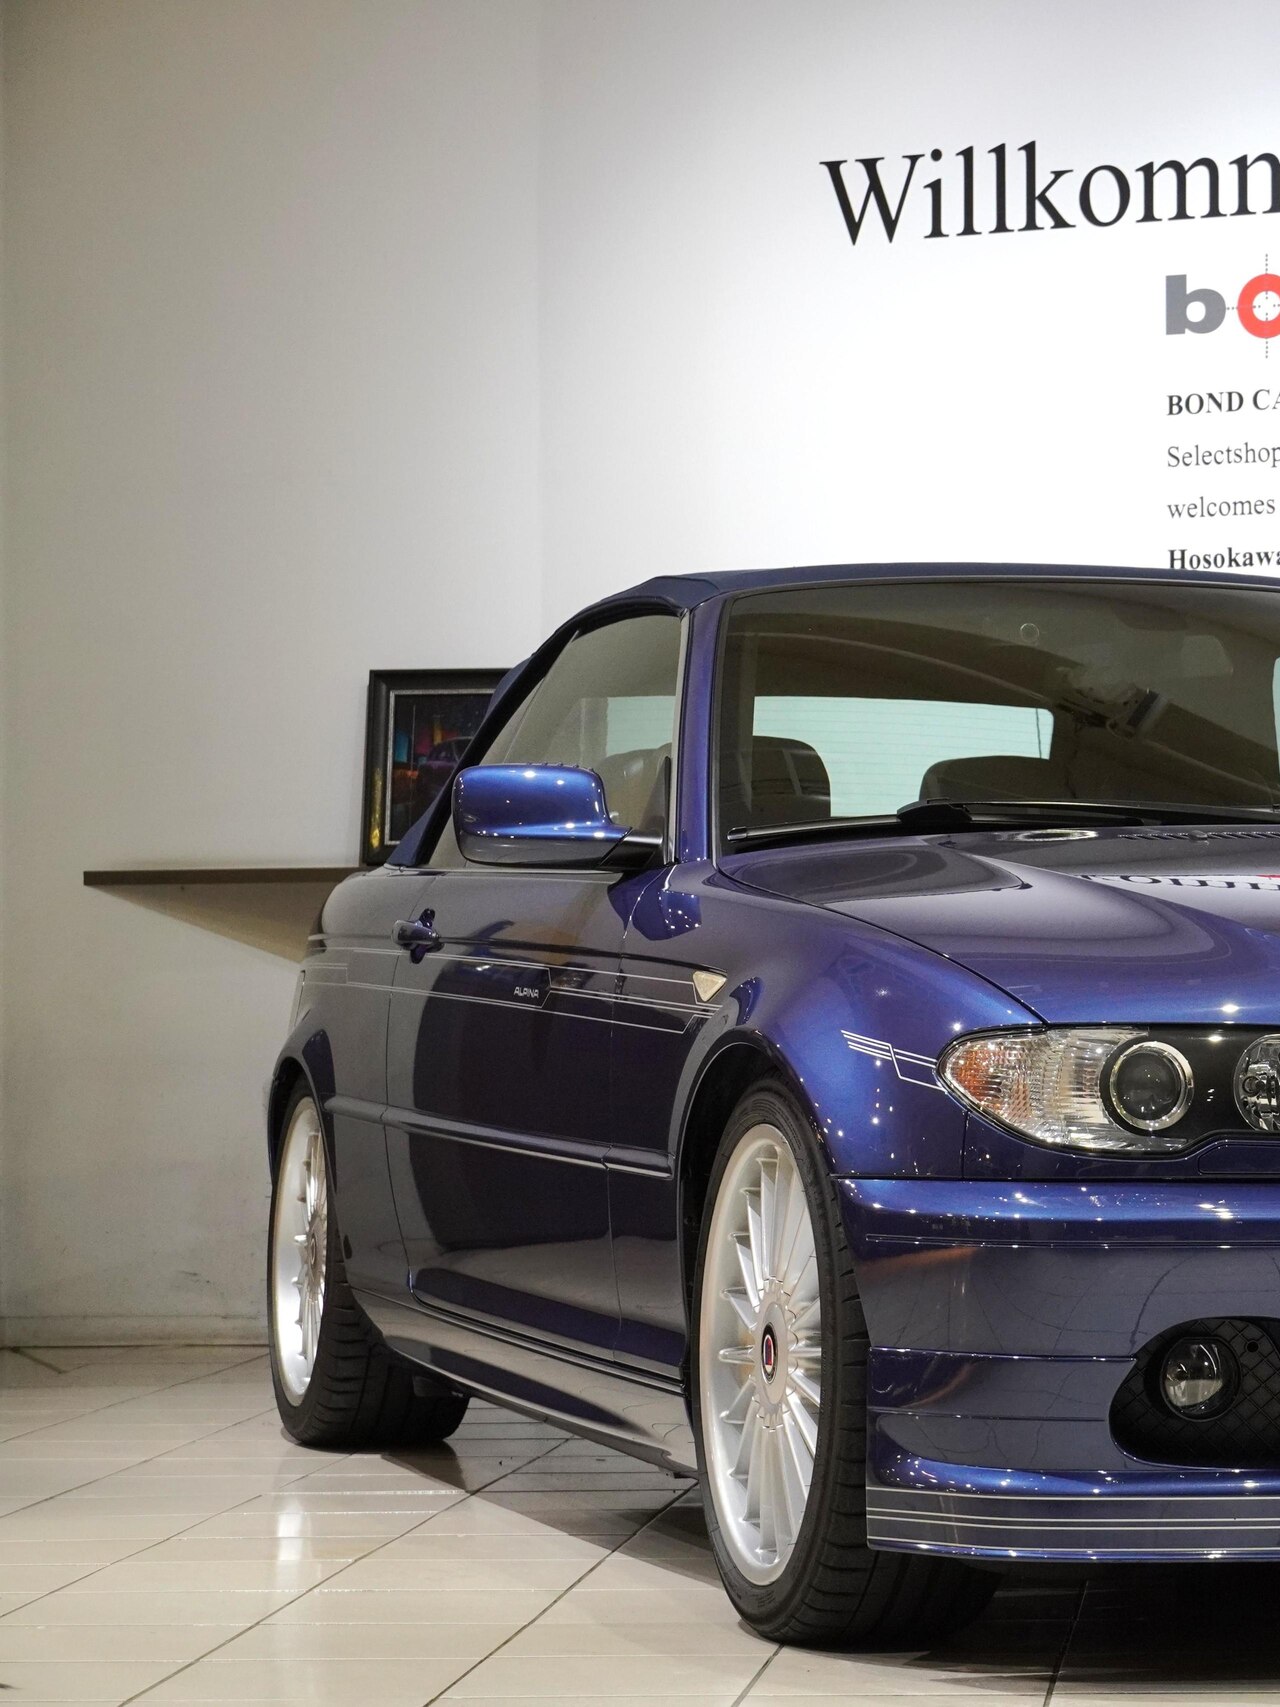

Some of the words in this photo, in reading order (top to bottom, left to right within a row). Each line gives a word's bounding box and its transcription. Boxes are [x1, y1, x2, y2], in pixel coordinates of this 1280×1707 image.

[1166, 389, 1245, 416] BOND
[1166, 494, 1276, 520] welcomes
[513, 986, 540, 999] ALPINA
